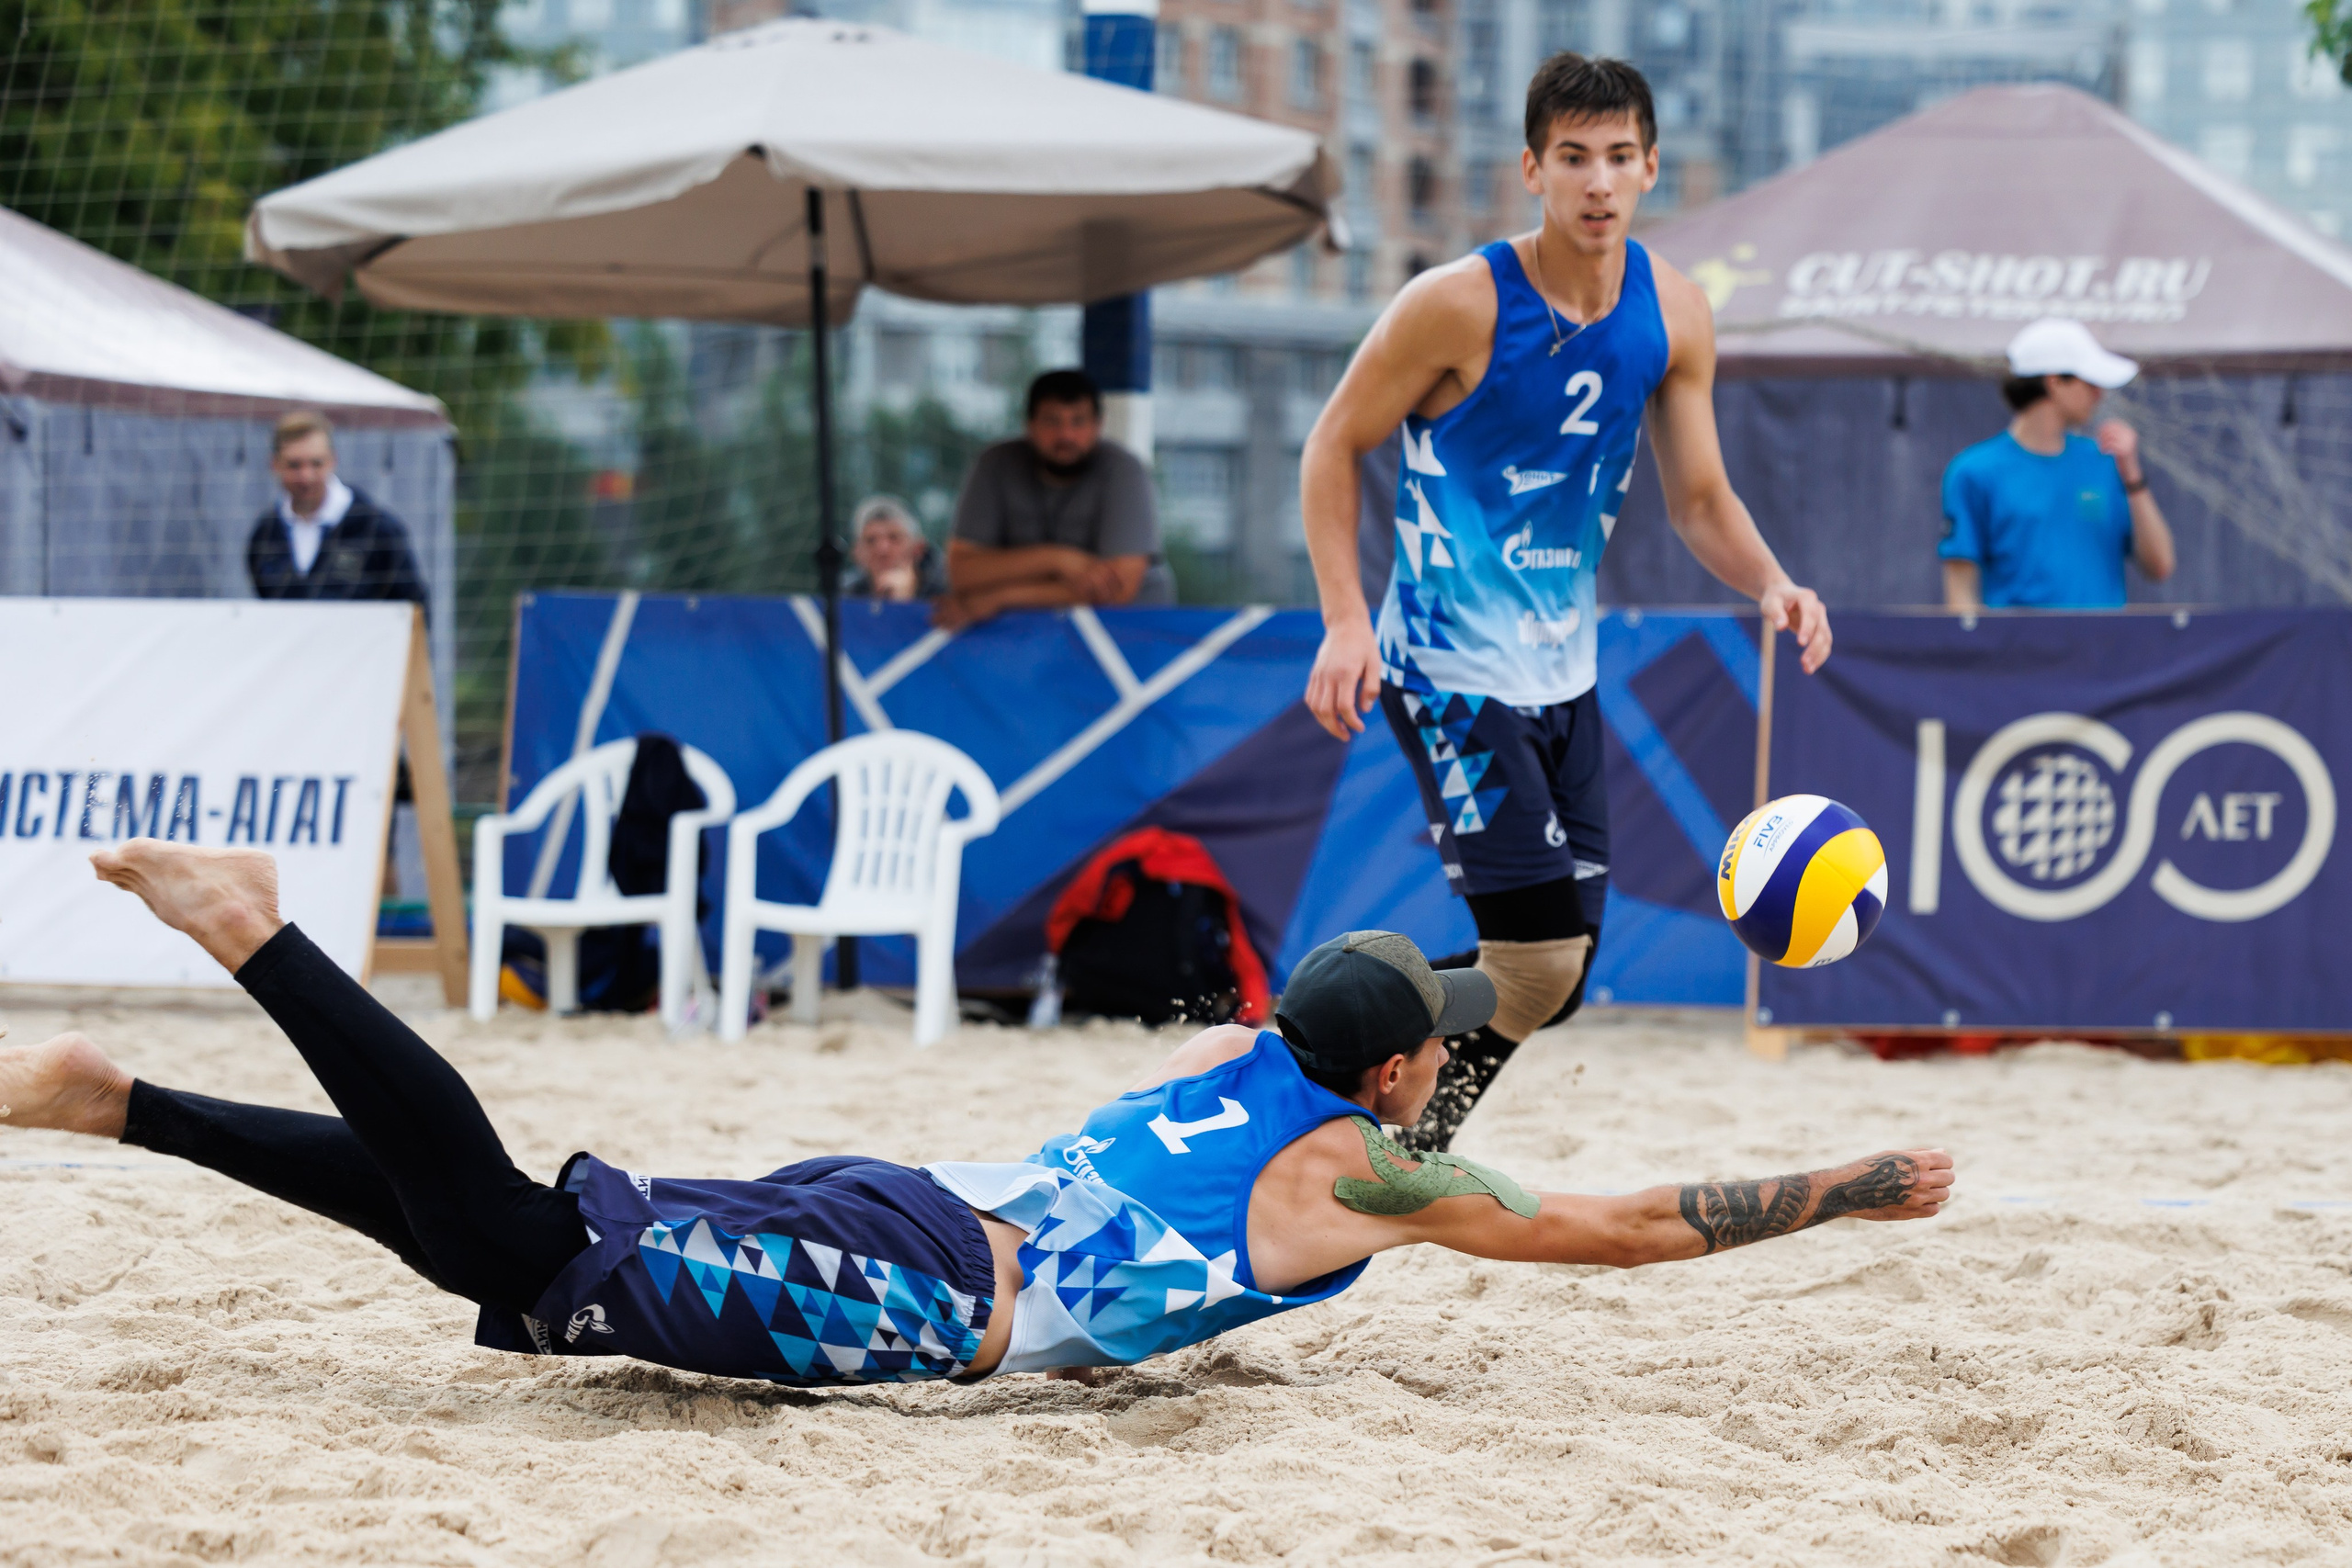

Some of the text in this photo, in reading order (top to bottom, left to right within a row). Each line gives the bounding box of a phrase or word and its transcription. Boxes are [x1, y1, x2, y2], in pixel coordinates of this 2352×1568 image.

[1786, 248, 2212, 301] CUT-SHOT.RU
[1559, 370, 1603, 435] 2
[2180, 792, 2284, 841] ЛЕТ
[1147, 1096, 1250, 1155] 1
